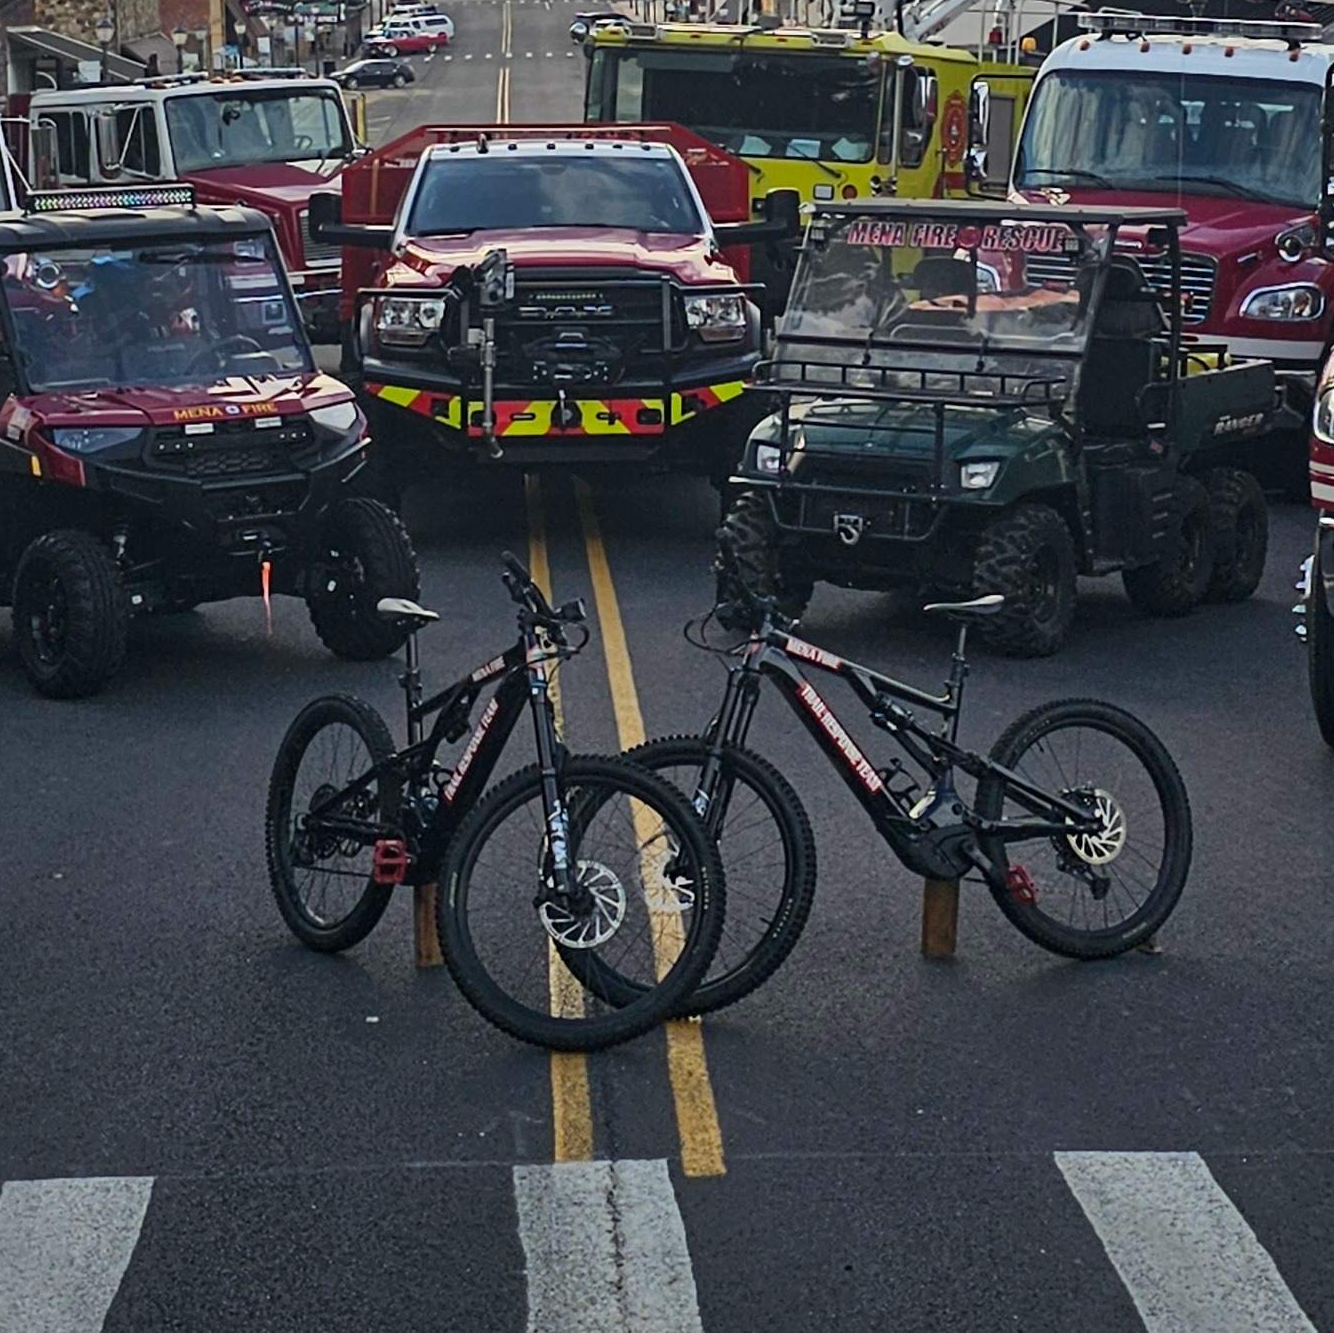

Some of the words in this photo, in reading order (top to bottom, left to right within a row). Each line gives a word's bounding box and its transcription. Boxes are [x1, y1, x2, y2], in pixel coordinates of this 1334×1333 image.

[846, 221, 907, 247] MENA
[910, 223, 958, 249] FIRE
[980, 224, 1068, 252] RESCUE
[173, 407, 224, 420] MENA
[240, 402, 279, 414] FIRE
[785, 637, 818, 661] MENA
[480, 696, 499, 729] TEAM
[801, 684, 828, 718] TRAIL
[820, 711, 863, 766] RESPONSE
[855, 758, 883, 792] TEAM
